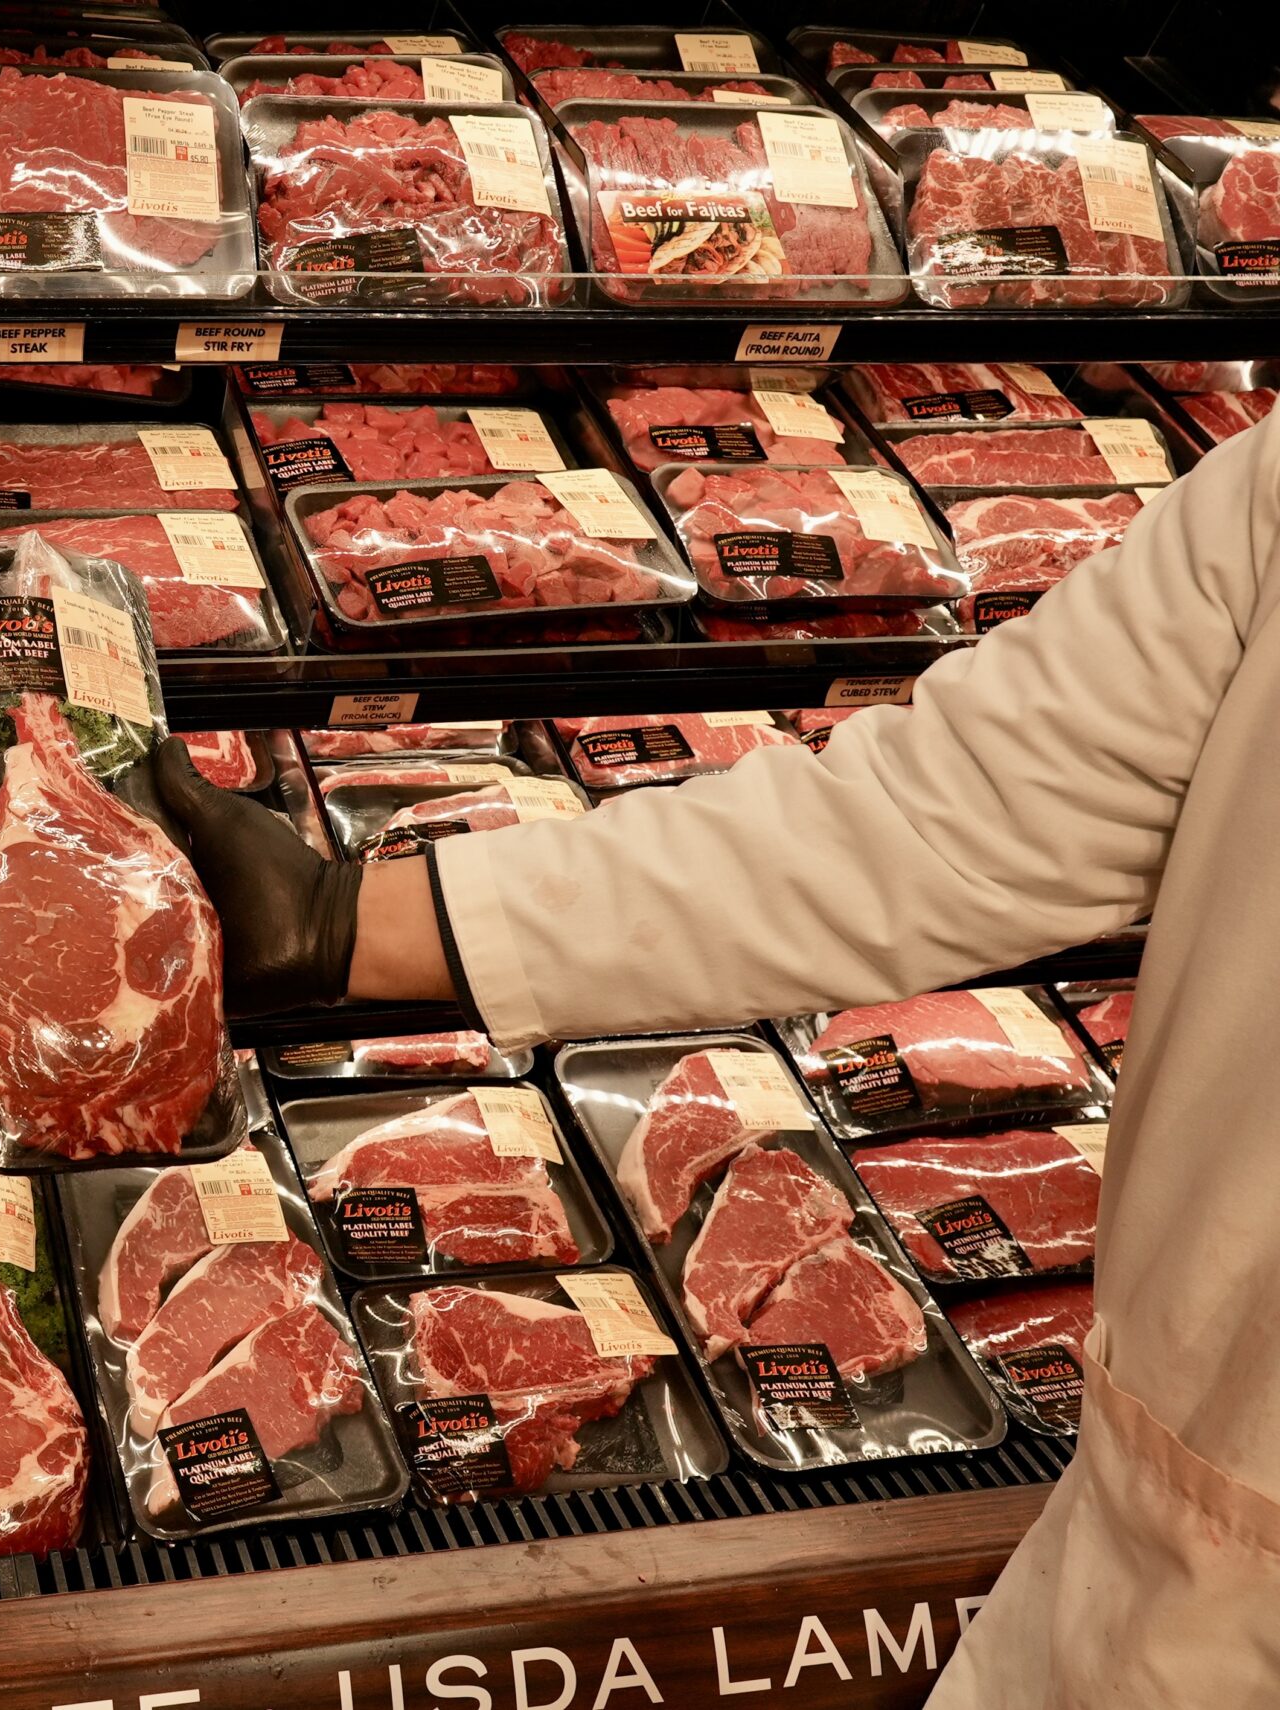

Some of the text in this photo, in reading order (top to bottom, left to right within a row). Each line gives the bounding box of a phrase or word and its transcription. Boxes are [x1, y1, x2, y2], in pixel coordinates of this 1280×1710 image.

[132, 198, 179, 214] Livoti's
[622, 200, 746, 220] Beef for Fajitas
[1222, 255, 1280, 269] Livoti's
[23, 328, 66, 339] PEPPER
[195, 327, 266, 338] BEEF ROUND
[759, 330, 821, 342] BEEF FAJITA
[10, 343, 47, 354] STEAK
[203, 340, 254, 352] STIR FRY
[745, 344, 825, 357] (FROM ROUND)
[913, 402, 960, 415] Livoti's
[656, 436, 707, 448] Livoti's
[267, 446, 331, 465] Livoti's
[723, 545, 779, 558] Livoti's
[375, 575, 432, 594] Livoti's
[840, 687, 900, 697] CUBED STEW
[341, 711, 401, 721] (FROM CHUCK)
[588, 737, 635, 753] Livoti's
[837, 1051, 897, 1073] Livoti's
[840, 1067, 901, 1086] PLATINUM LABEL
[848, 1075, 900, 1092] QUALITY BEEF
[343, 1201, 412, 1219] Livoti's
[343, 1222, 415, 1231] PLATINUM LABEL
[935, 1211, 993, 1236] Livoti's
[212, 1229, 254, 1241] Livoti's
[350, 1230, 410, 1239] QUALITY BEEF
[943, 1228, 1002, 1248] PLATINUM LABEL
[600, 1341, 643, 1352] Livoti's
[758, 1361, 829, 1377] Livoti's
[1009, 1362, 1074, 1382] Livoti's
[760, 1381, 836, 1390] PLATINUM LABEL
[771, 1390, 833, 1400] QUALITY BEEF
[417, 1412, 489, 1438] Livoti's
[175, 1429, 249, 1460] Livoti's
[216, 1447, 232, 1458] WORLD
[233, 1443, 250, 1452] MARKET
[179, 1451, 256, 1477] PLATINUM LABEL
[339, 1637, 663, 1710] USDA
